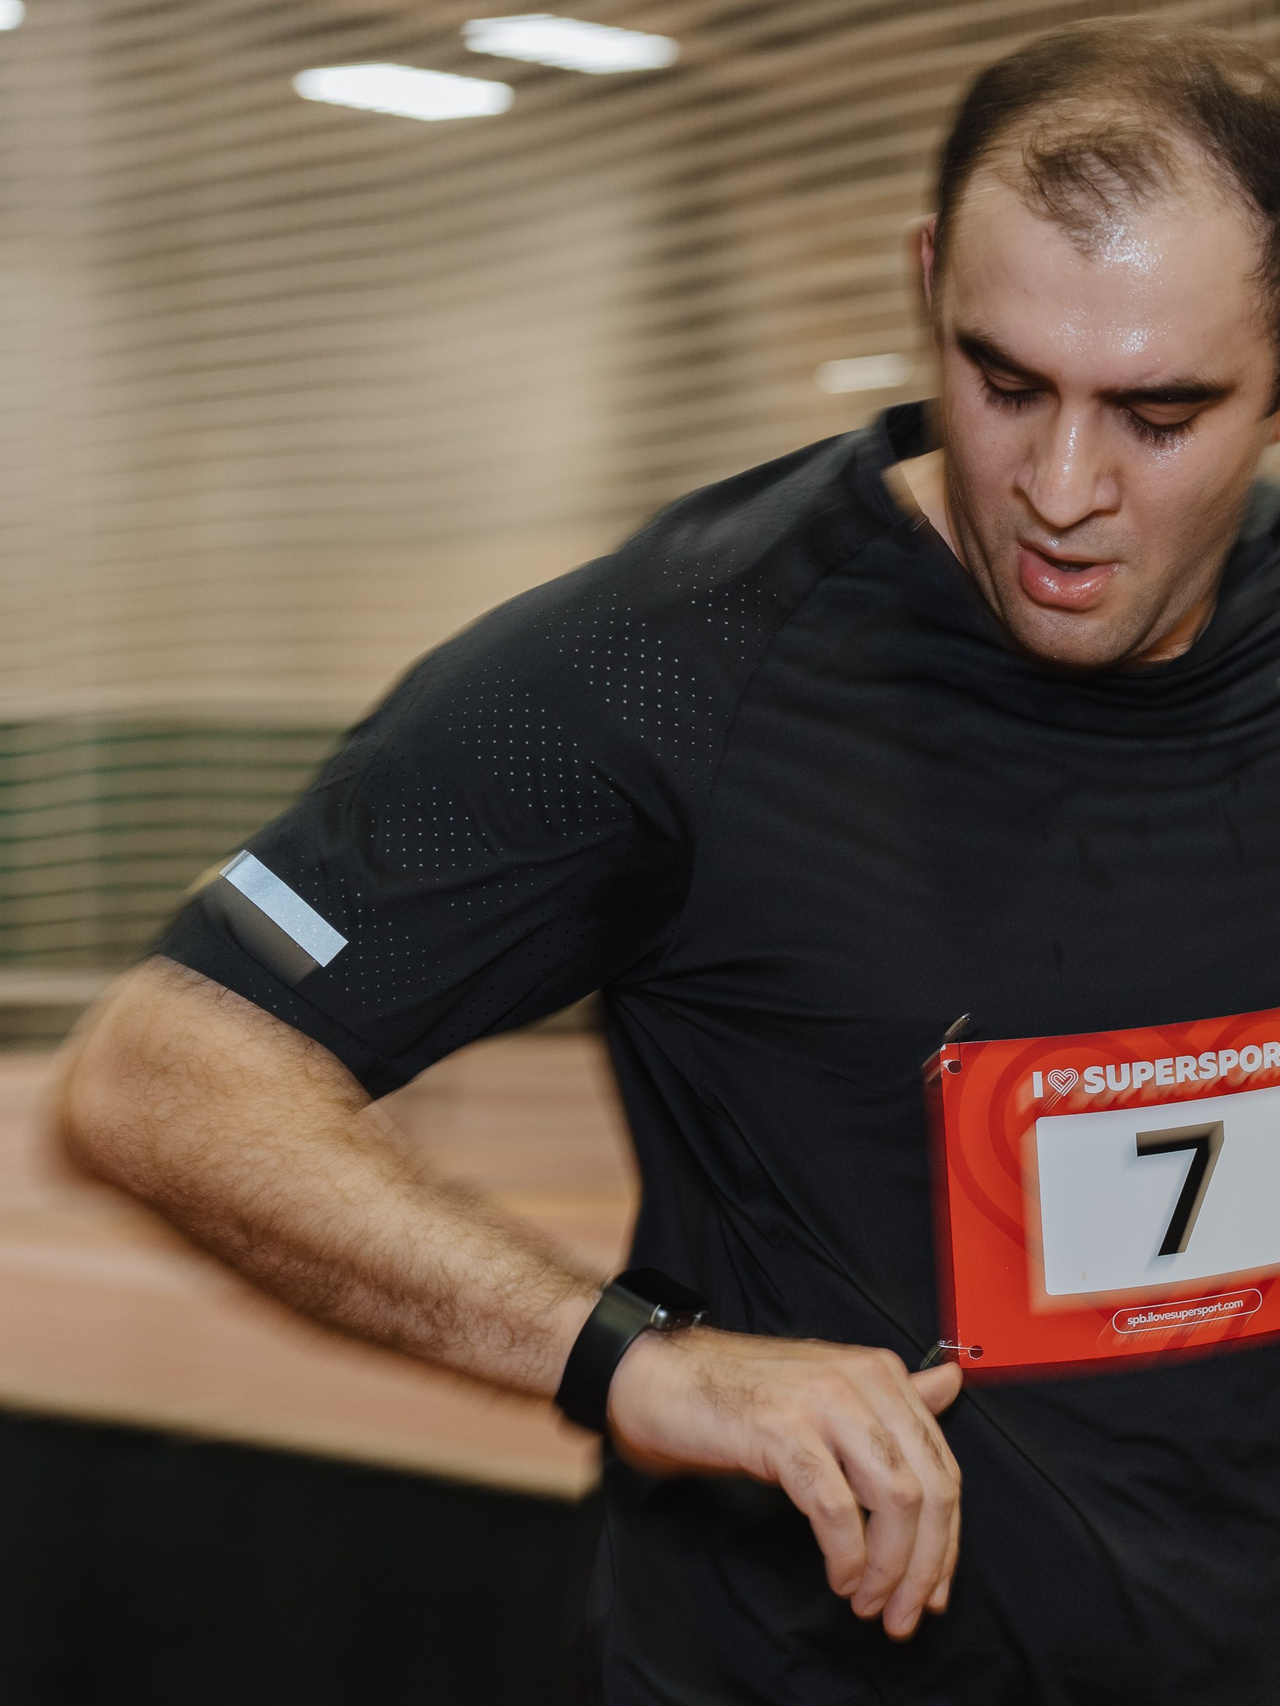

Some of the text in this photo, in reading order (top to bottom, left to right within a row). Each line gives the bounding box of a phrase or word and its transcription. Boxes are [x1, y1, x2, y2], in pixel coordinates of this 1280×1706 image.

[1032, 1071, 1044, 1098] I
[1135, 1120, 1225, 1257] 7
[1127, 1299, 1244, 1327] spb.ilovesupersport.com
